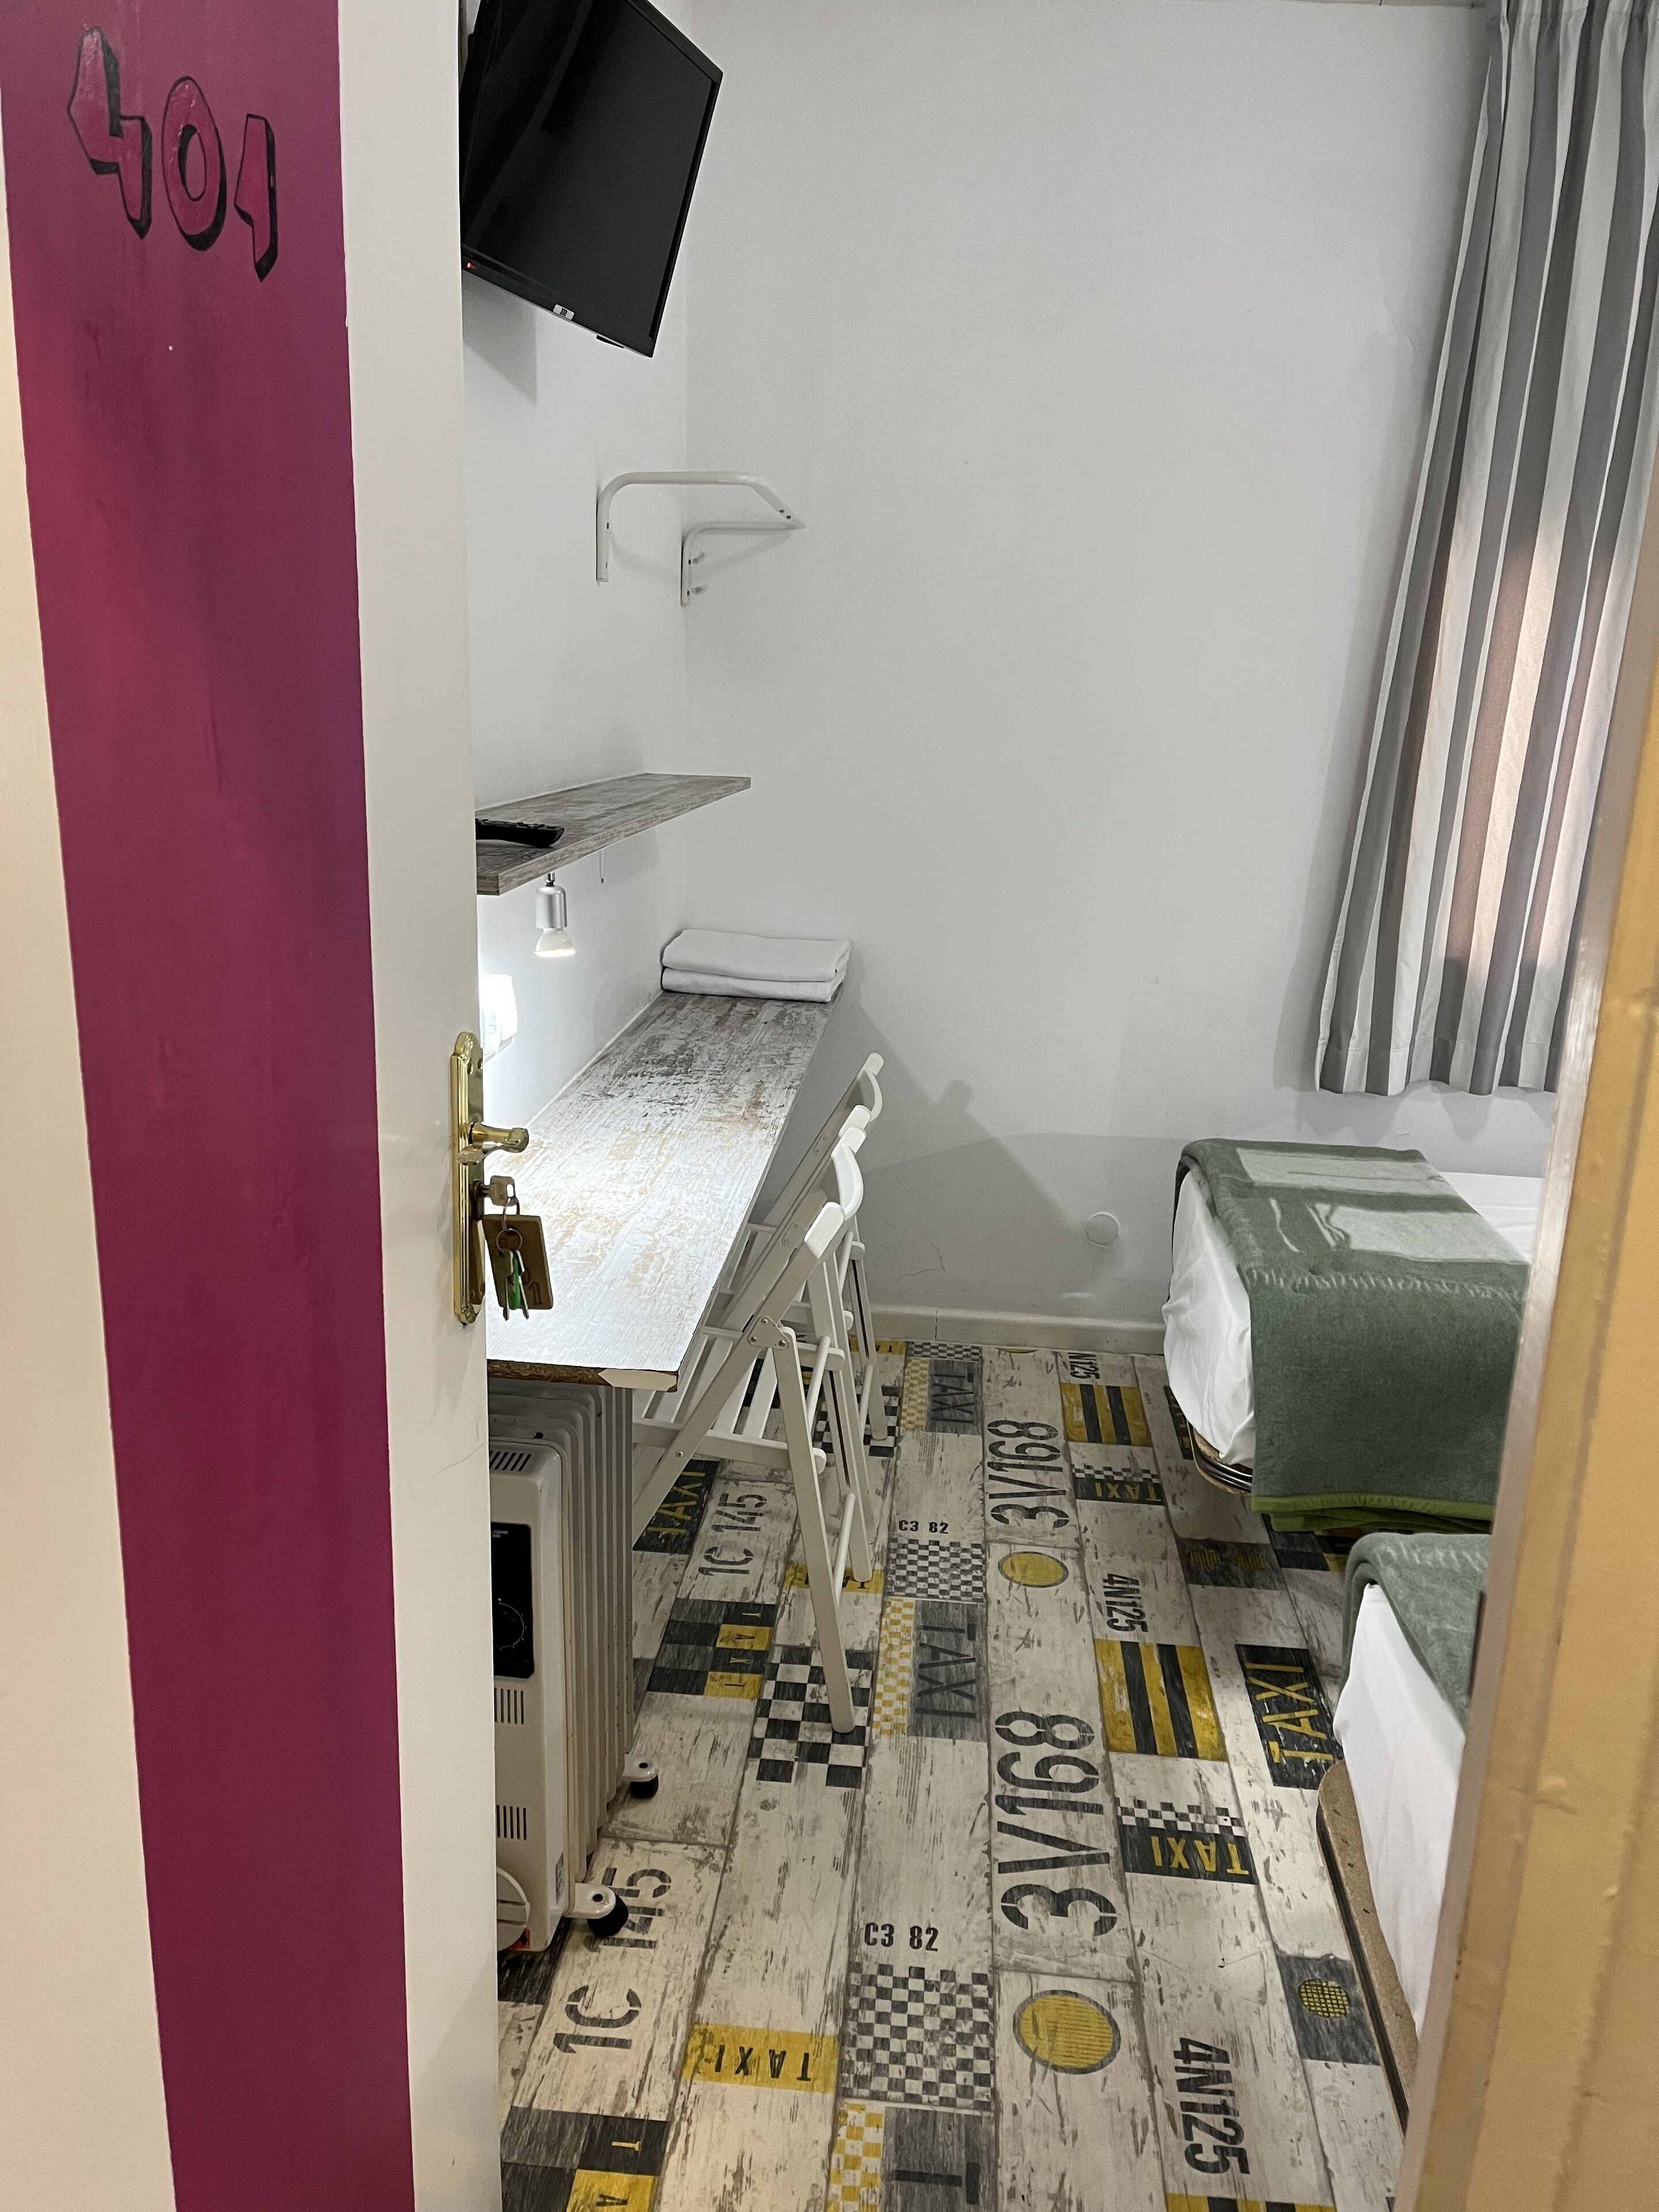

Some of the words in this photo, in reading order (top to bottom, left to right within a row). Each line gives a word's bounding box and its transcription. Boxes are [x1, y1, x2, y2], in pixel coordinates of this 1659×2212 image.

[67, 26, 278, 282] 401
[929, 1373, 975, 1423] TAXI
[987, 1419, 1070, 1528] 3V168
[1095, 1482, 1161, 1502] TAXI
[899, 1520, 919, 1532] C3
[929, 1521, 949, 1534] 82
[1103, 1573, 1149, 1633] 4N125
[916, 1623, 976, 1719] TAXI
[1244, 1662, 1334, 1763] TAXI
[995, 1711, 1118, 1937] 3V168
[1152, 1835, 1249, 1876] TAXI
[864, 1922, 895, 1948] C3
[909, 1925, 938, 1952] 82
[714, 2044, 811, 2082] TAXI
[1173, 2037, 1251, 2175] 4N125
